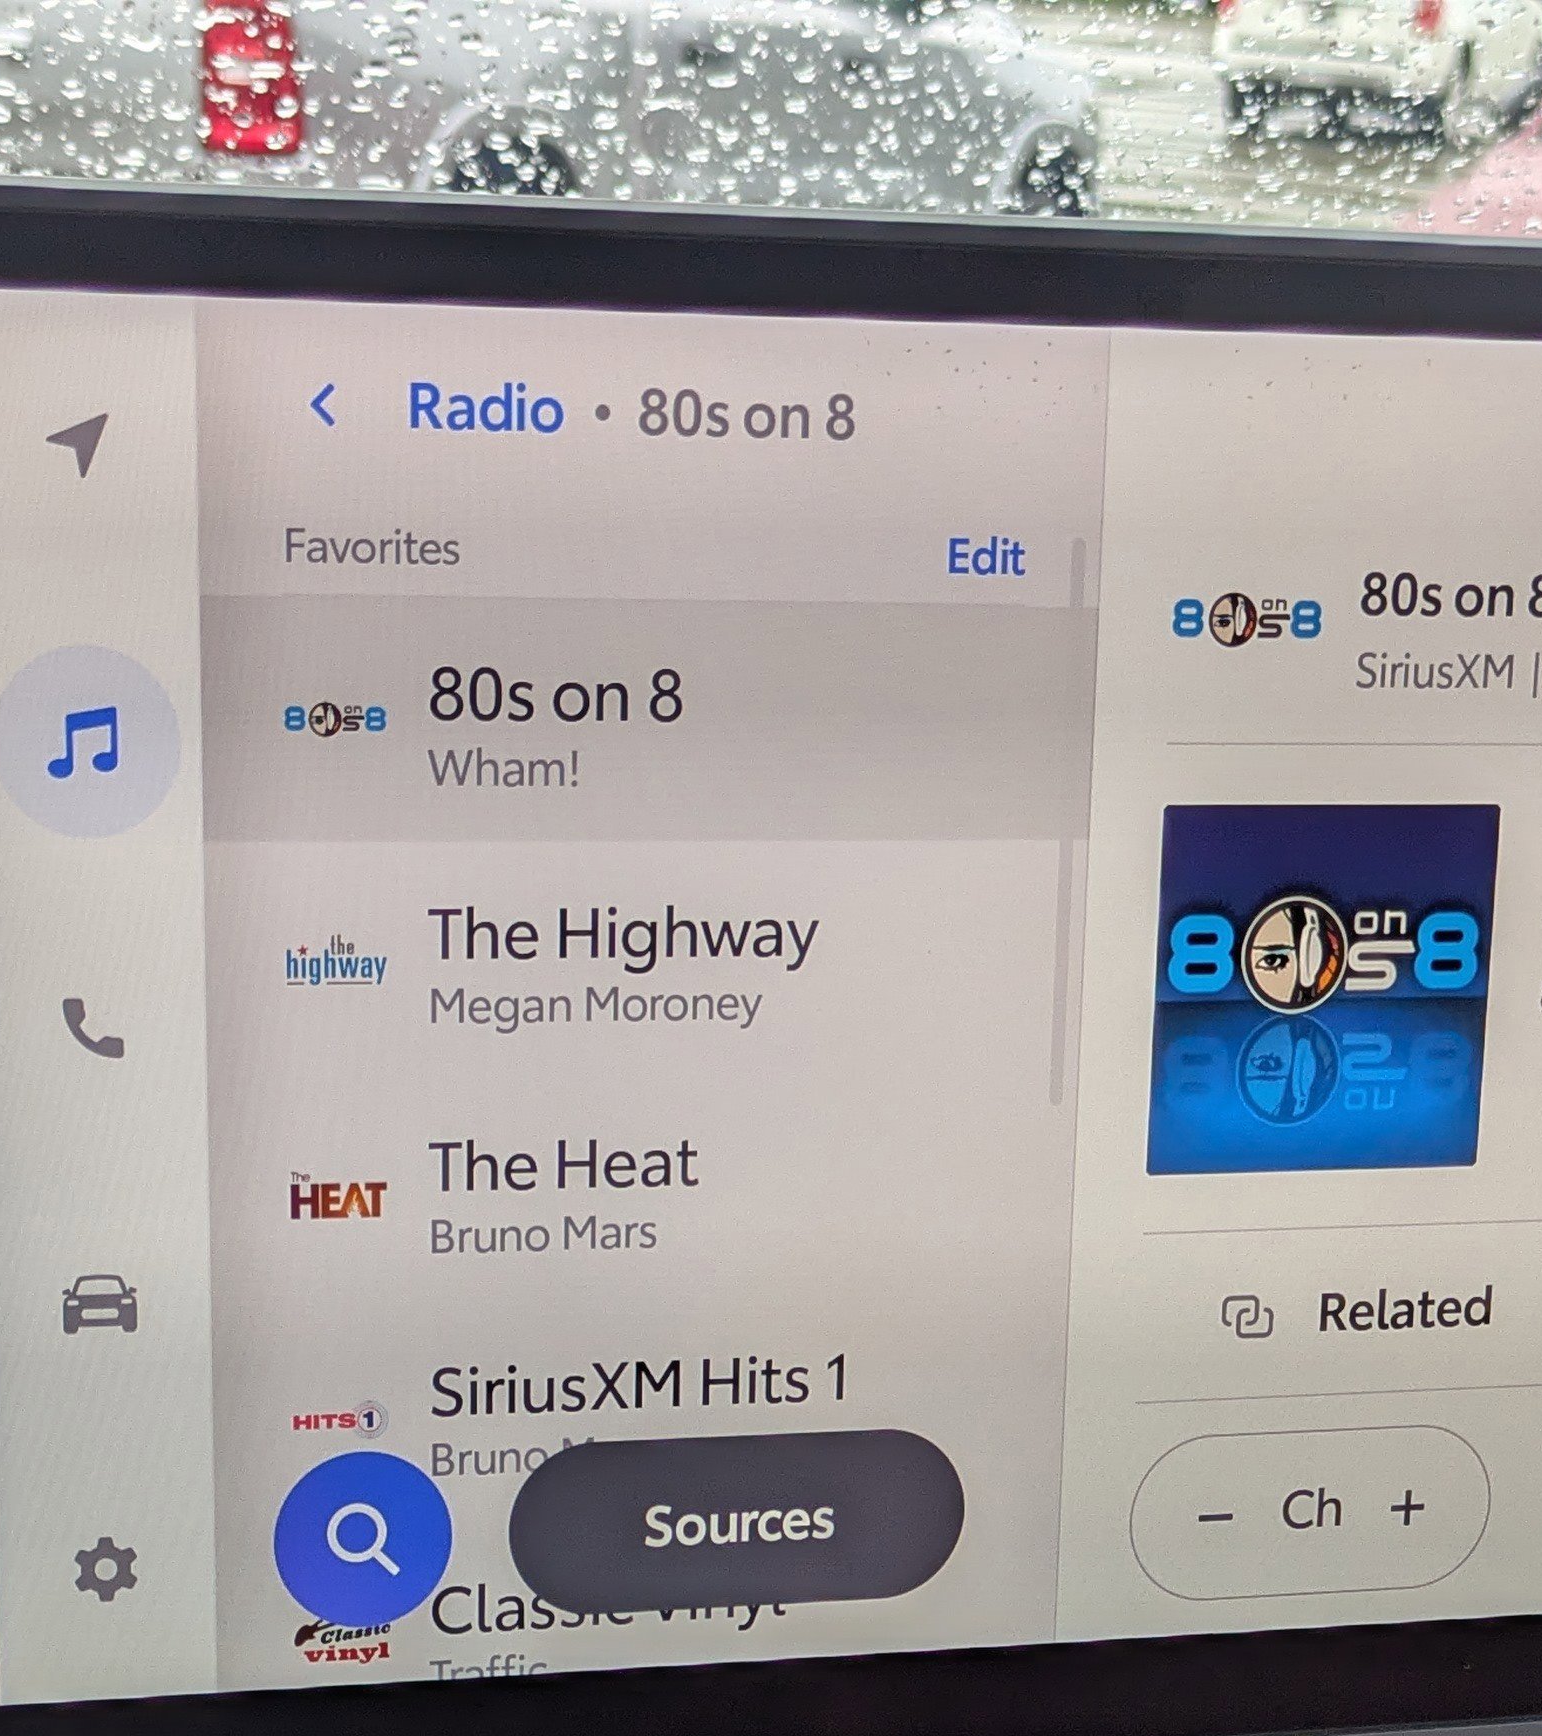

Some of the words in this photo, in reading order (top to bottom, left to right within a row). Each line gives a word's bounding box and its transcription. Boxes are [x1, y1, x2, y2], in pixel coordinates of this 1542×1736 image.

[410, 382, 564, 433] Radio
[639, 388, 729, 437] 80s
[744, 403, 809, 438] on
[826, 394, 855, 441] 8
[286, 528, 460, 565] Favorites
[948, 536, 1025, 576] Edit
[1361, 572, 1442, 616] 80s
[1455, 584, 1514, 617] on
[1356, 652, 1514, 689] SiriusXM
[430, 666, 534, 722] 80s
[553, 682, 628, 722] on
[650, 669, 682, 722] 8
[428, 747, 578, 787] Wham!
[328, 934, 354, 958] the
[428, 906, 538, 960] The
[559, 905, 819, 974] Highway
[286, 943, 387, 984] highway
[431, 988, 571, 1034] Megan
[586, 986, 762, 1029] Moroney
[290, 1172, 311, 1186] The
[429, 1139, 537, 1191] The
[558, 1139, 698, 1189] Heat
[291, 1182, 387, 1219] HEAT
[432, 1219, 550, 1254] Bruno
[564, 1216, 656, 1250] Mars
[1320, 1284, 1492, 1331] Related
[432, 1360, 680, 1417] SiriusXM
[702, 1355, 809, 1405] Hits
[828, 1354, 844, 1400] 1
[292, 1413, 357, 1430] HITS
[431, 1441, 548, 1479] Bruno
[645, 1505, 834, 1547] Sources
[1283, 1488, 1341, 1529] Ch
[304, 1642, 389, 1664] vinyl
